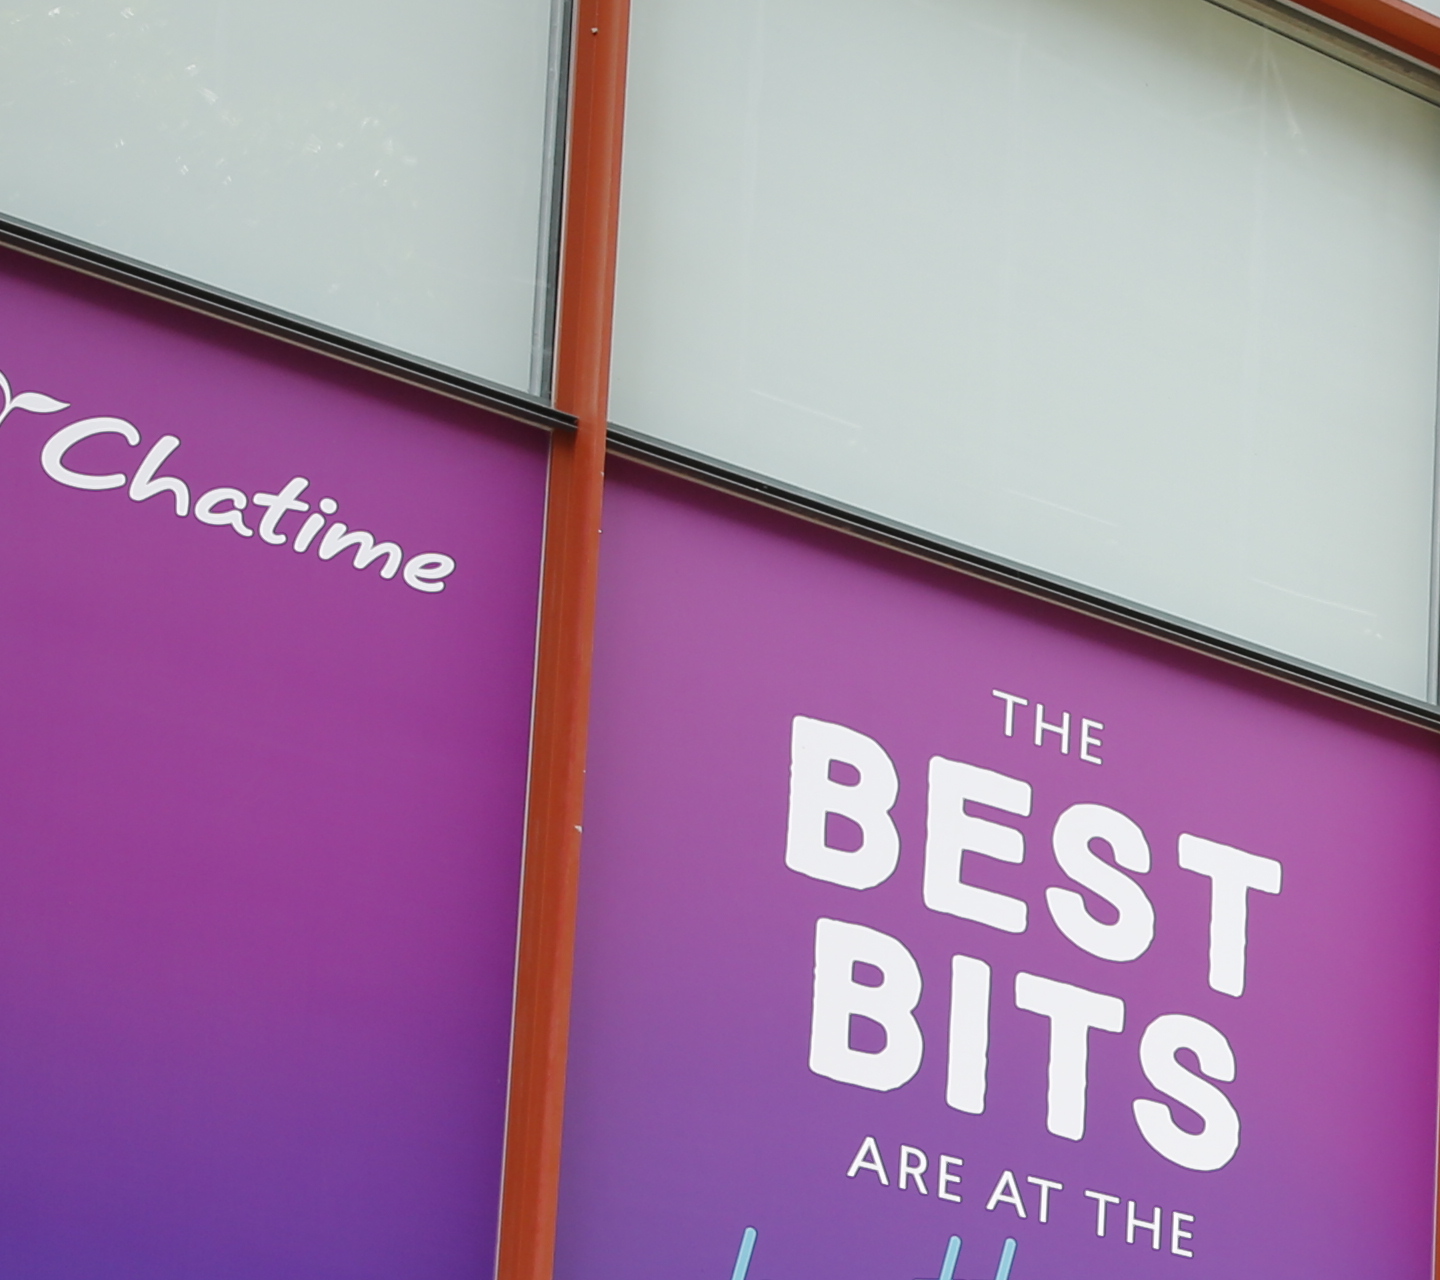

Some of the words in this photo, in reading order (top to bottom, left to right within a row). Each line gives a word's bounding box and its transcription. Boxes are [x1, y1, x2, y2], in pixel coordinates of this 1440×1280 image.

[40, 415, 458, 595] Chatime
[990, 688, 1106, 766] THE
[784, 715, 1284, 998] BEST
[807, 916, 1242, 1173] BITS
[846, 1135, 965, 1204] ARE
[986, 1170, 1063, 1225] AT
[1085, 1190, 1196, 1259] THE
